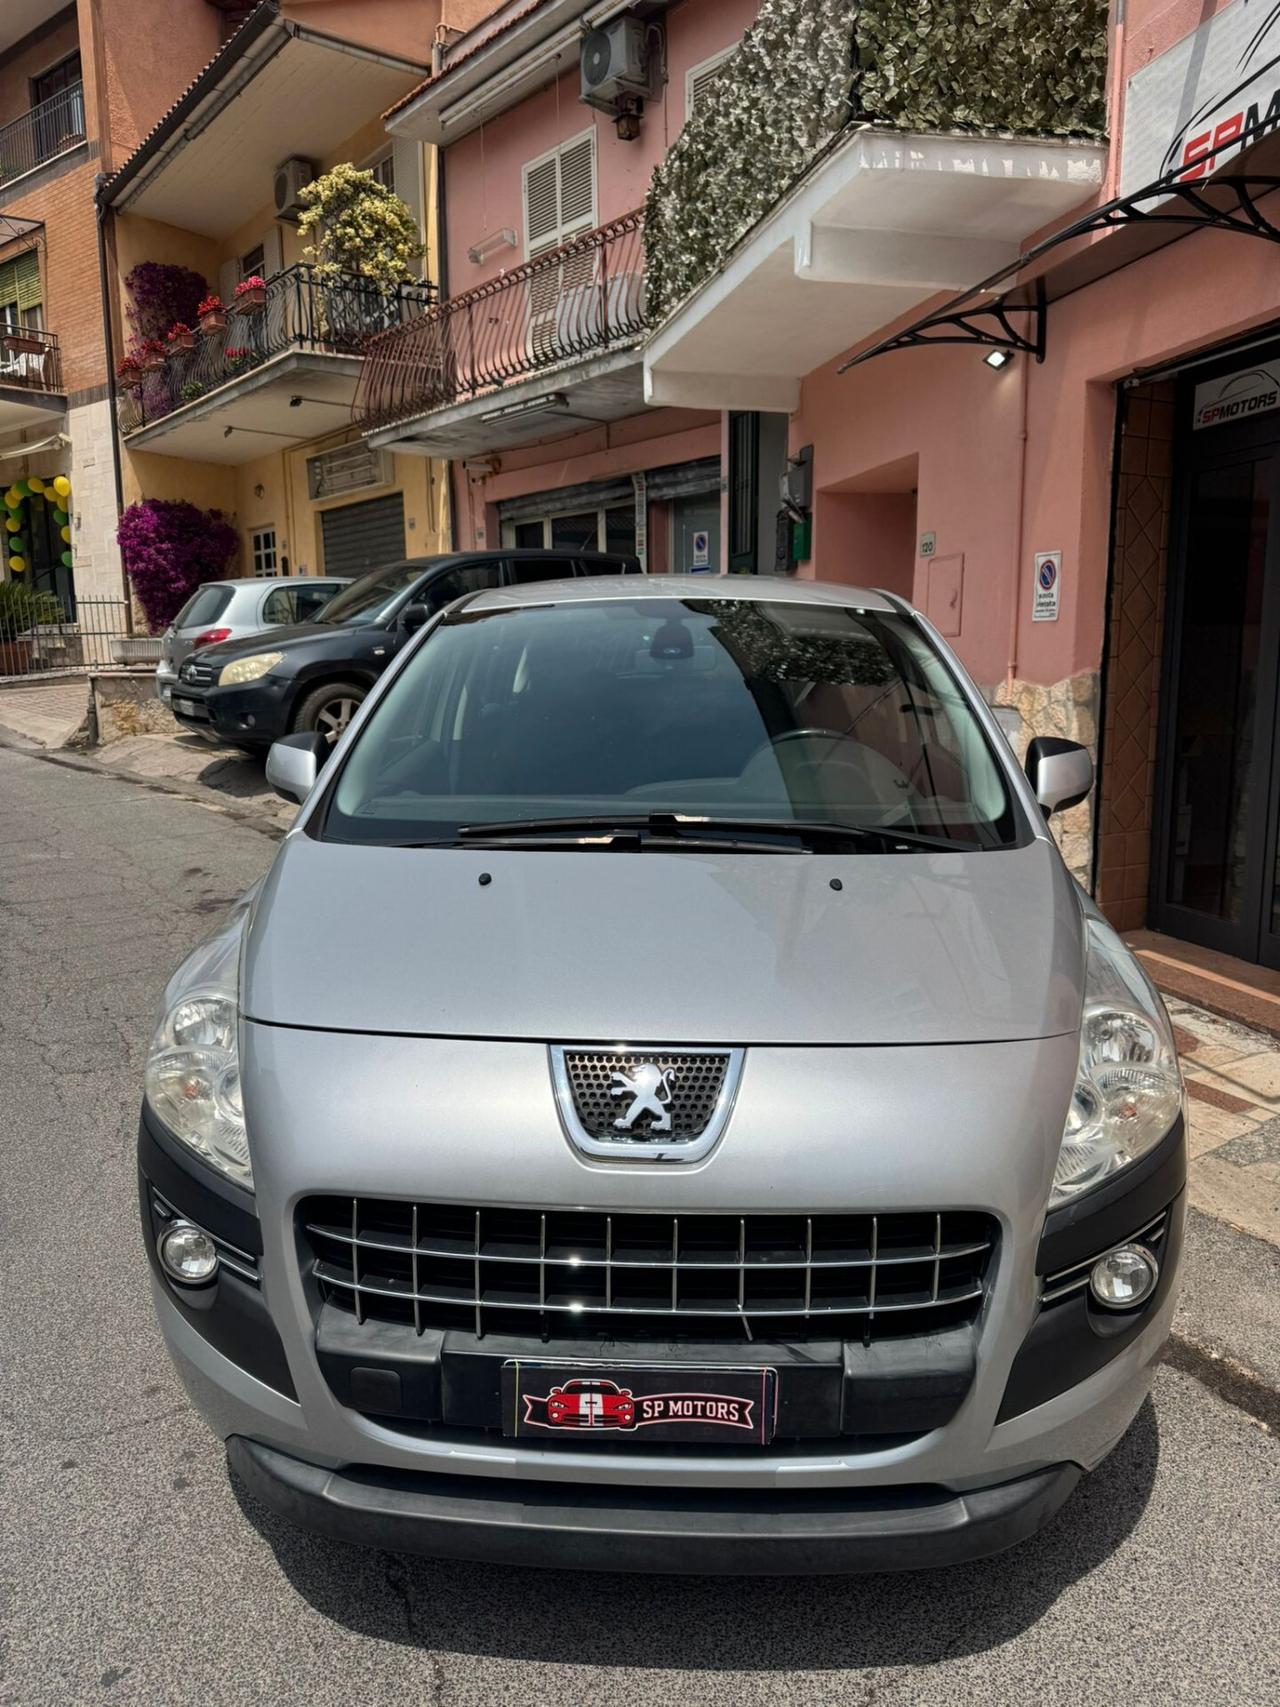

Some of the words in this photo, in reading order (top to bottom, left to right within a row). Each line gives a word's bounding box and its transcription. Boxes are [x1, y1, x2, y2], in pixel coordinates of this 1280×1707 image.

[1202, 390, 1278, 424] SPMOTORS
[643, 1400, 664, 1418] SP
[668, 1400, 739, 1421] MOTORS
